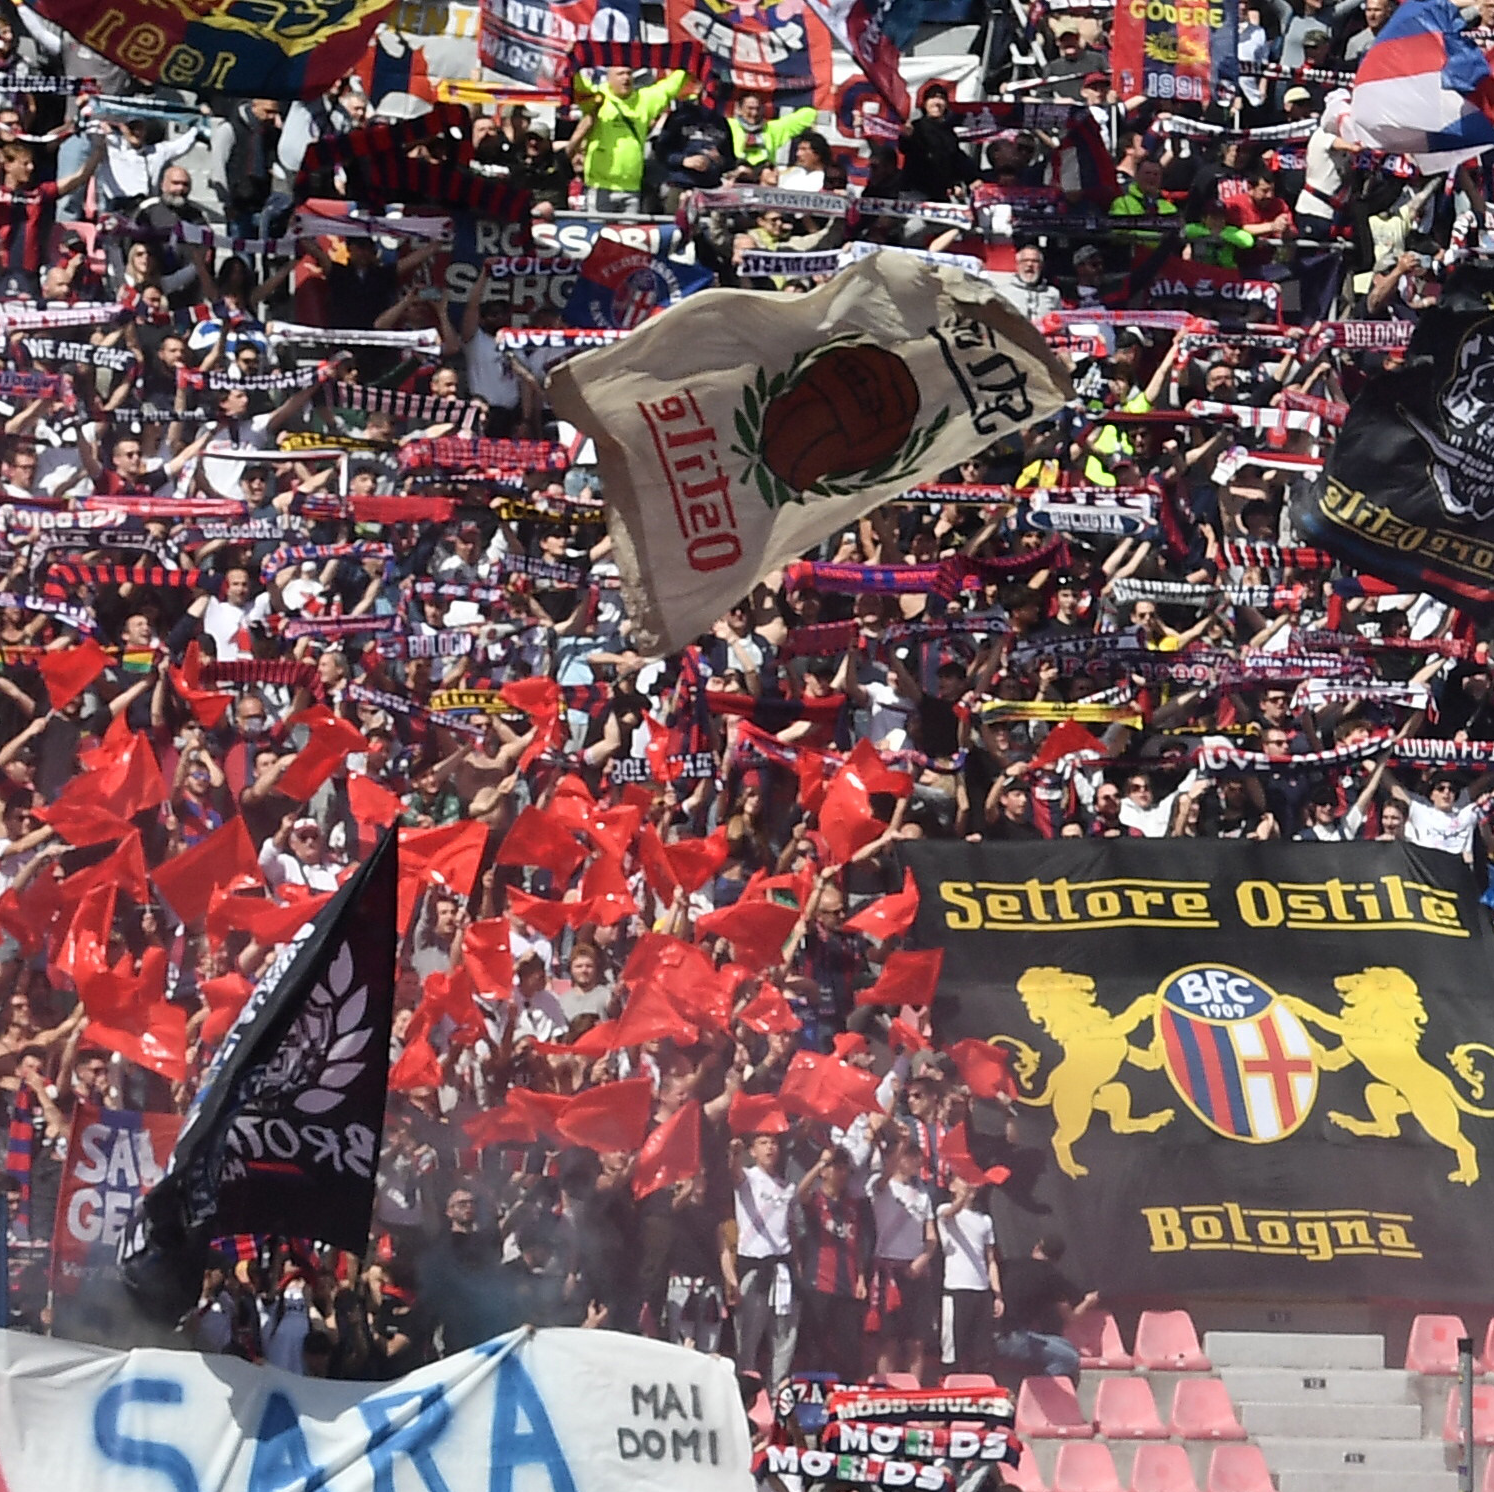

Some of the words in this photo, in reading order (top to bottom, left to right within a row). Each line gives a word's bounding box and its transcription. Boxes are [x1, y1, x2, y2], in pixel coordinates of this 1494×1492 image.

[1126, 0, 1221, 29] GODERE
[1146, 72, 1204, 101] 1991
[23, 338, 54, 359] WE
[58, 342, 90, 362] ARE
[92, 345, 136, 371] ONE
[939, 877, 1219, 932] Settore
[1235, 874, 1467, 938] Ostile
[1176, 969, 1255, 1005] BFC
[1199, 1003, 1245, 1020] 1909
[1140, 1202, 1421, 1262] Bologna
[630, 1383, 703, 1422] MAI
[617, 1426, 720, 1468] DOMI
